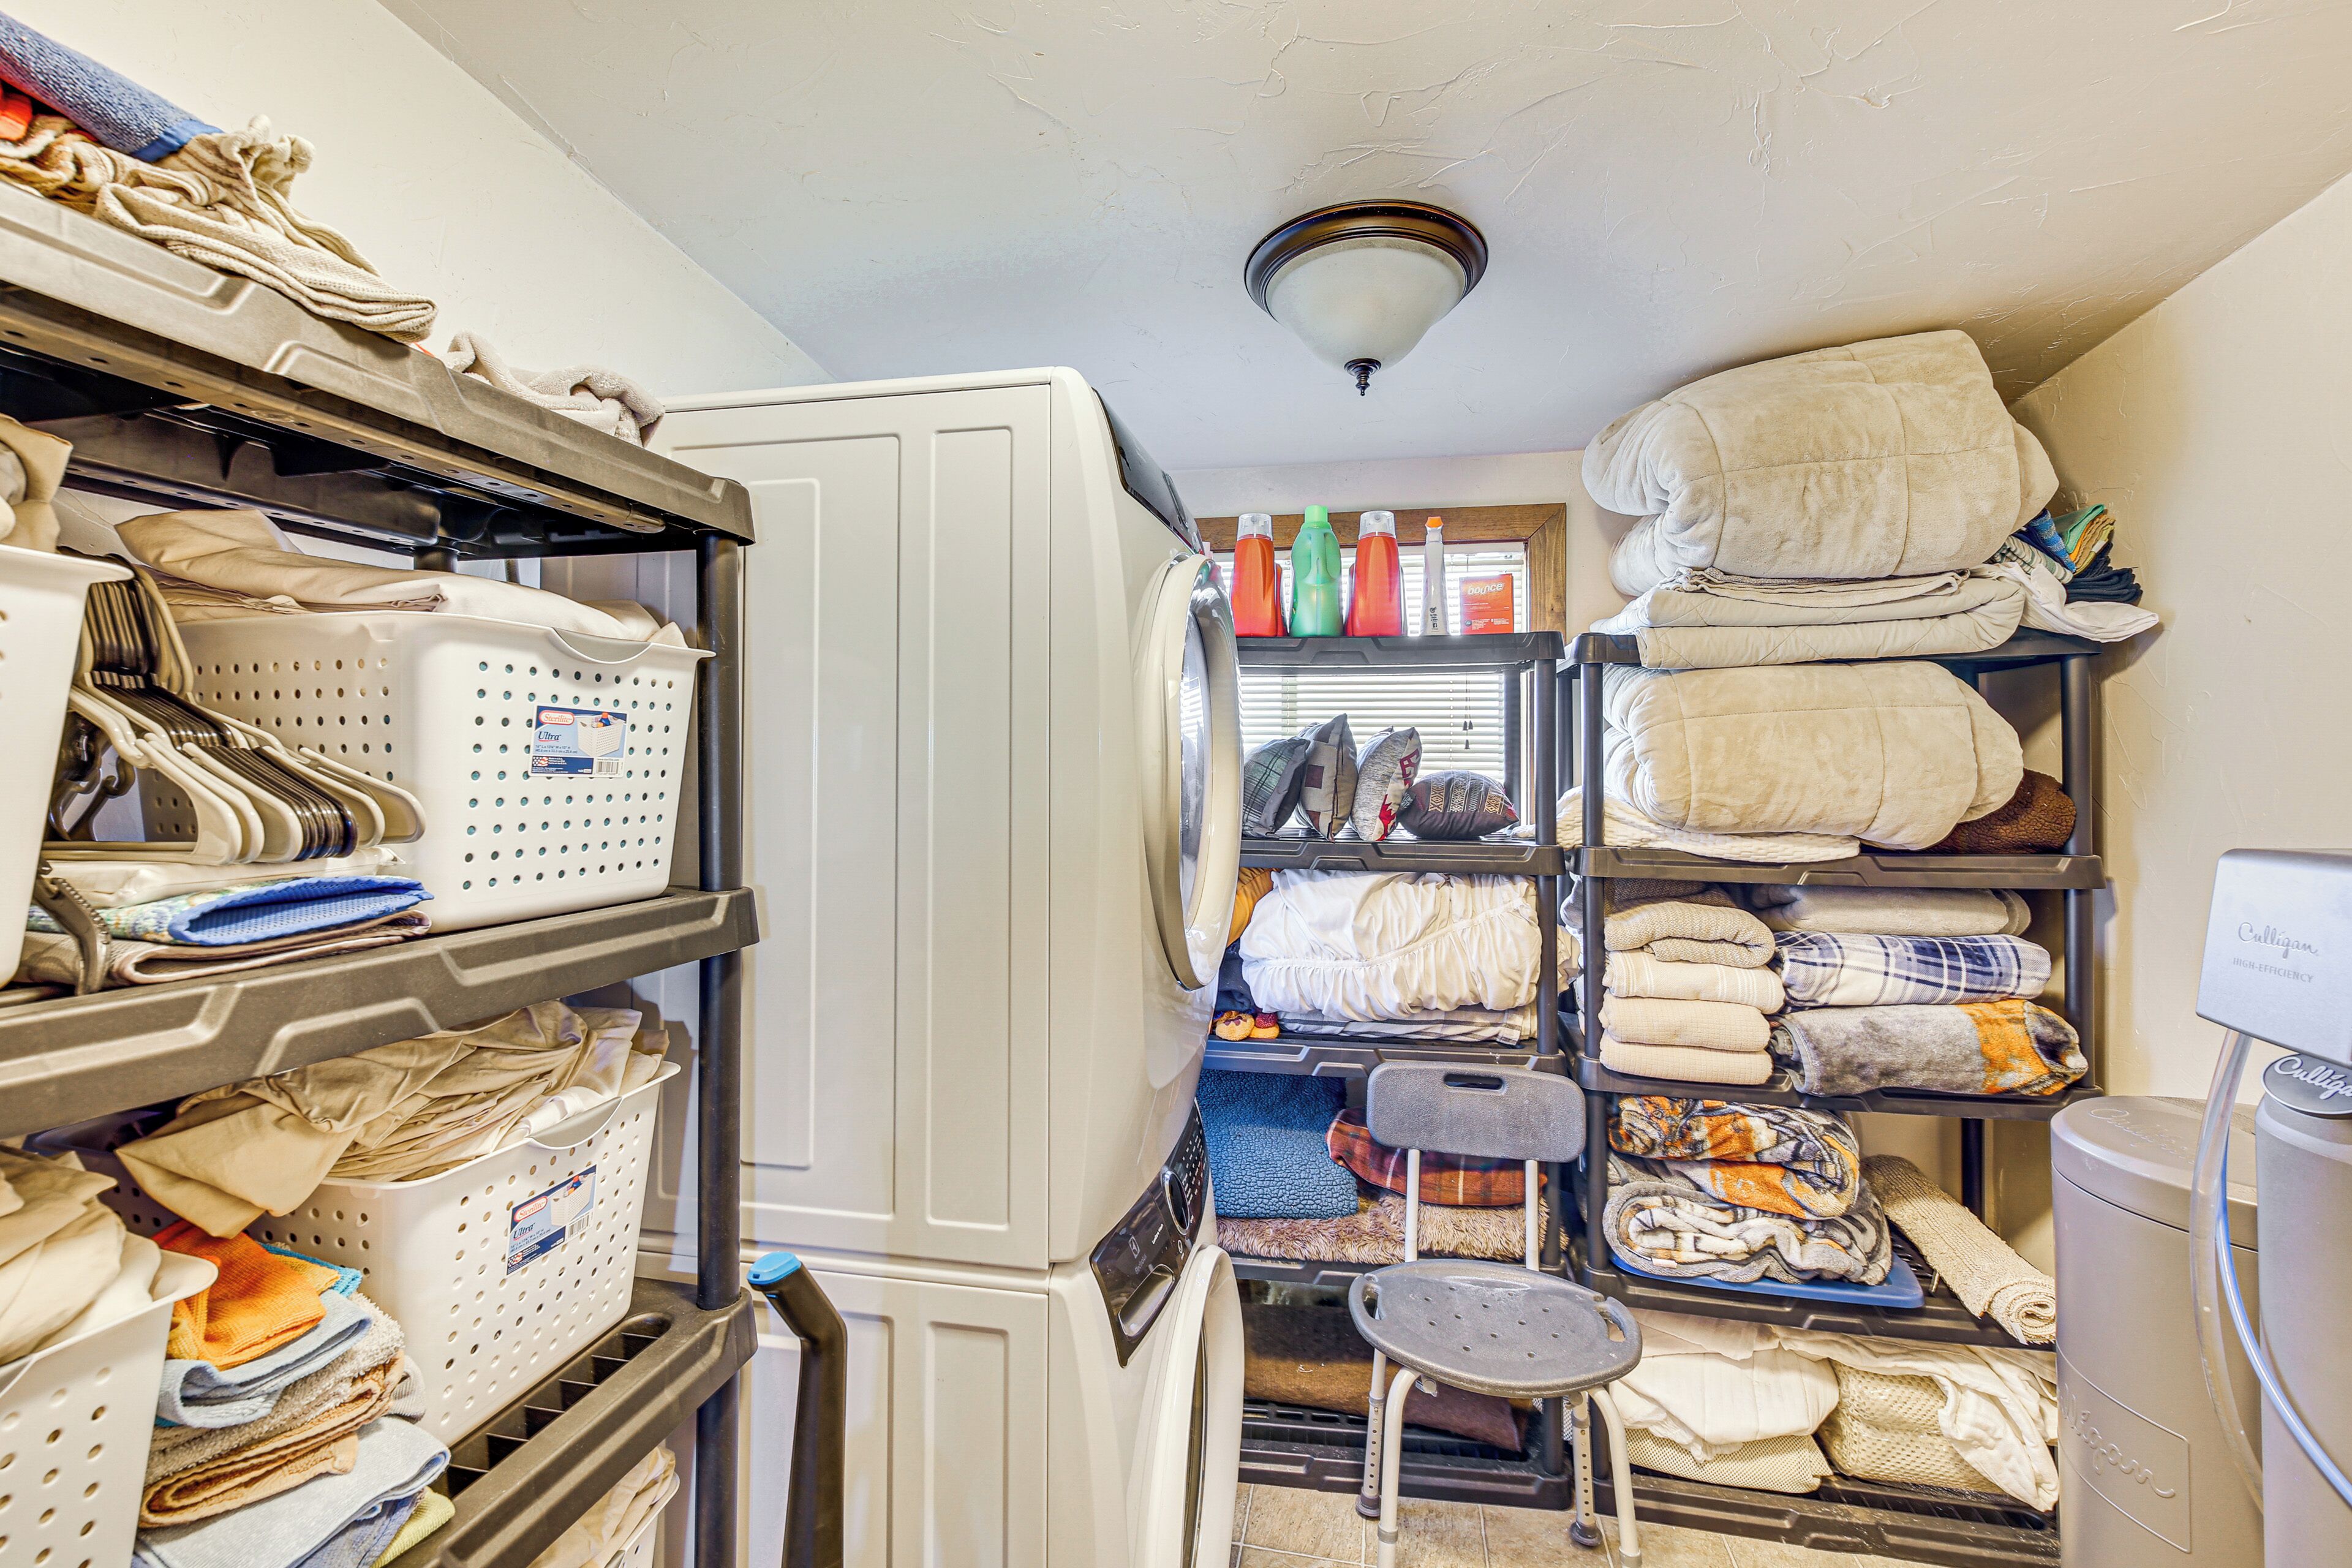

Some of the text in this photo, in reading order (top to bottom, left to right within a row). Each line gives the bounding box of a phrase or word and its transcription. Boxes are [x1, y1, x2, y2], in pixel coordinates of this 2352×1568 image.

[1468, 581, 1504, 595] bounce
[544, 714, 570, 723] Sterilite
[538, 731, 560, 741] Ultra
[2238, 922, 2318, 960] Culligan
[2233, 957, 2314, 983] HIGH-EFFICIENCY
[2274, 1056, 2352, 1100] Culliga
[518, 1202, 543, 1219] Sterilite
[513, 1224, 534, 1238] Ultra
[2058, 1382, 2176, 1498] ulligan
